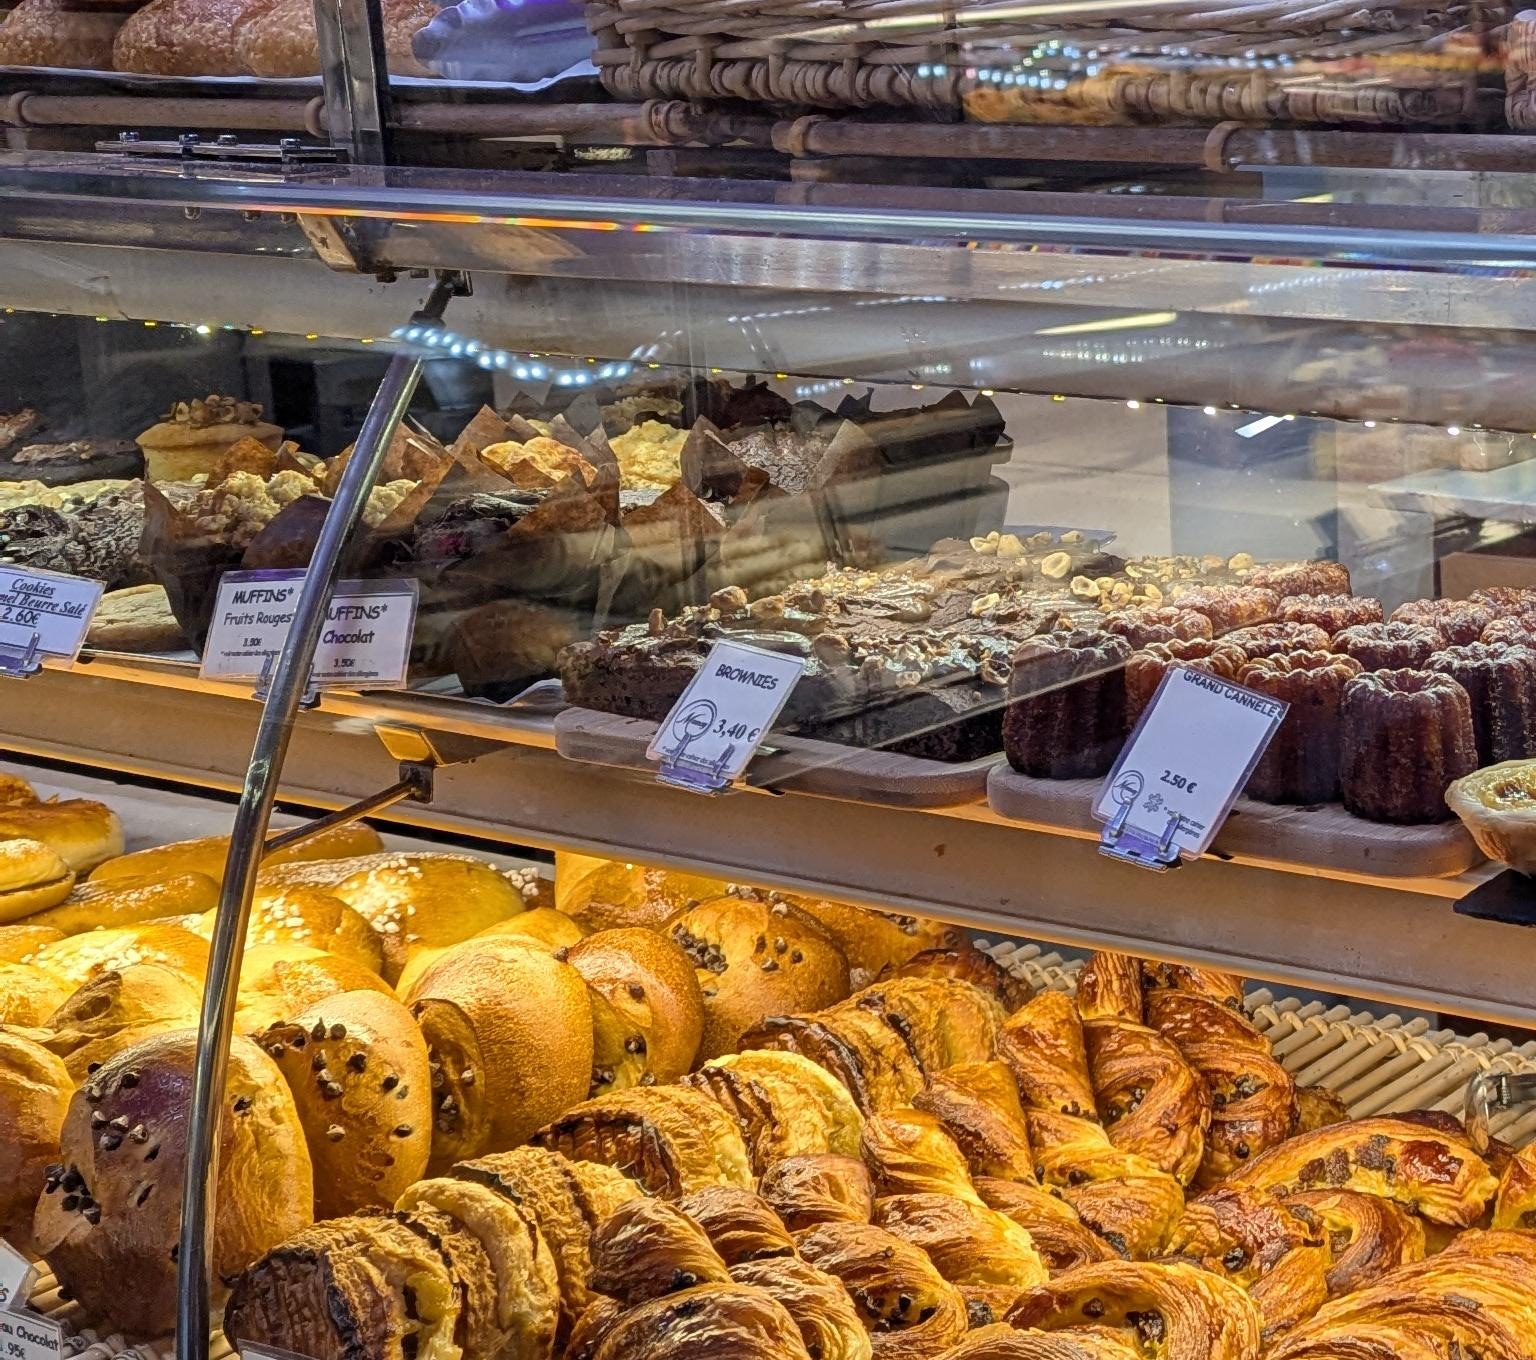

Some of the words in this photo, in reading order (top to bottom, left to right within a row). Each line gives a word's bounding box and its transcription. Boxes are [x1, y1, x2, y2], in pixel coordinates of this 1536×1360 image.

[12, 578, 56, 596] Cookies
[2, 606, 41, 625] 2.60€
[19, 593, 60, 611] Beurre
[60, 601, 88, 616] Salé
[325, 603, 388, 621] UFFINS
[223, 612, 253, 627] Fruits
[255, 611, 292, 627] Rouges
[322, 630, 375, 644] Chocolat
[715, 663, 779, 690] BROWNIES
[1183, 670, 1223, 695] GRAND
[712, 719, 747, 739] 3,40
[747, 727, 761, 742] €
[1160, 770, 1187, 789] 2.50
[1187, 781, 1198, 794] €
[16, 1325, 58, 1351] Chocolat
